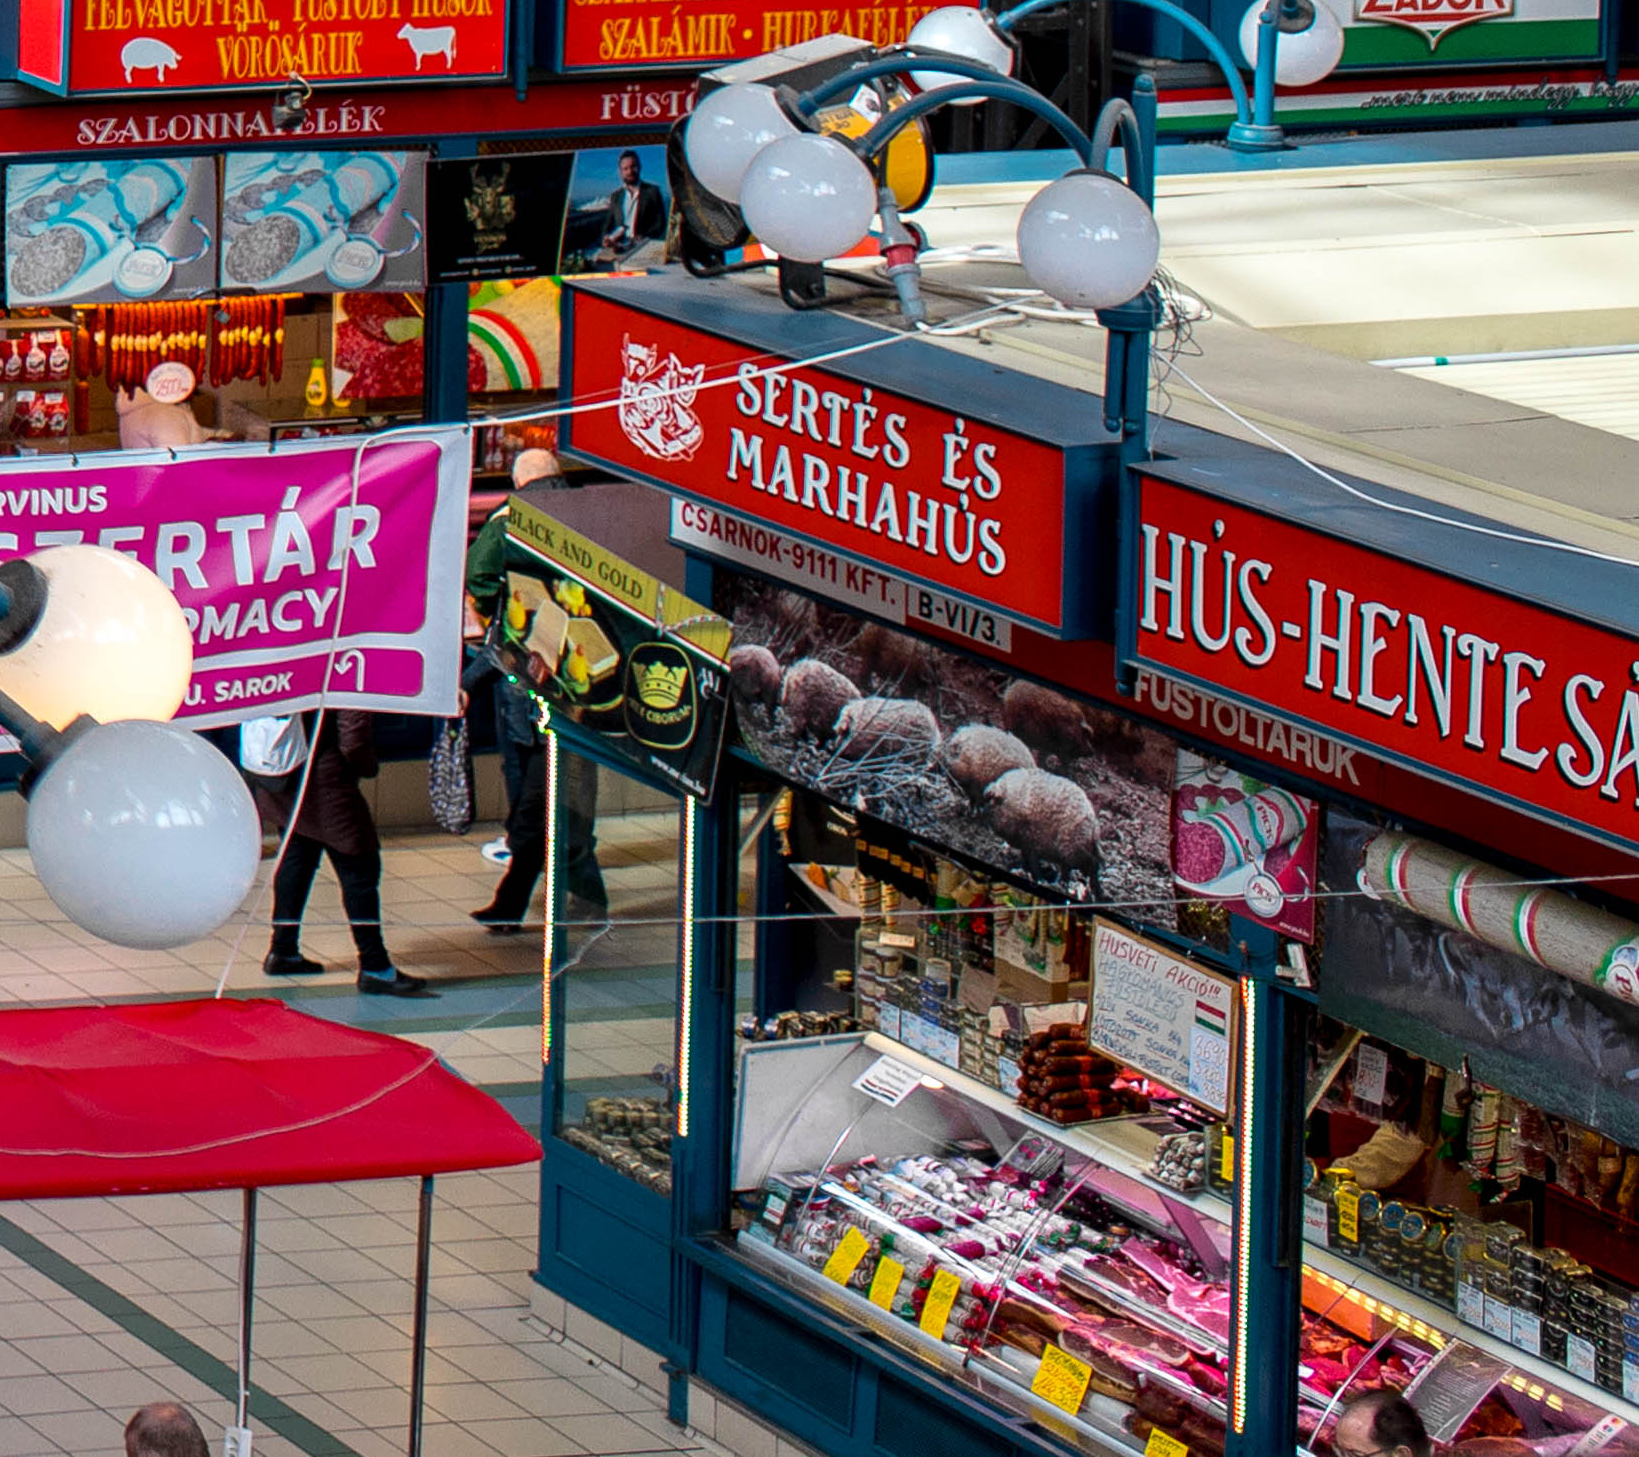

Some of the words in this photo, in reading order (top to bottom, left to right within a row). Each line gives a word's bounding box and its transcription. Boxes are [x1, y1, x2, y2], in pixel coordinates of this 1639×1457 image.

[215, 19, 364, 80] VÖRÖSÁRUK
[598, 5, 737, 62] SZALÁMIK
[77, 99, 386, 145] SZALONNAELÉK
[735, 362, 911, 469] SERTÉS
[941, 417, 1003, 501] ÉS
[726, 426, 1008, 577] MARHAHÚS
[559, 534, 593, 571] AND
[598, 560, 644, 602] GOLD
[680, 501, 839, 580] CSARNOK-9111
[846, 562, 897, 605] KFT.
[917, 593, 1002, 647] B-VI/3.
[214, 671, 292, 703] SAROK
